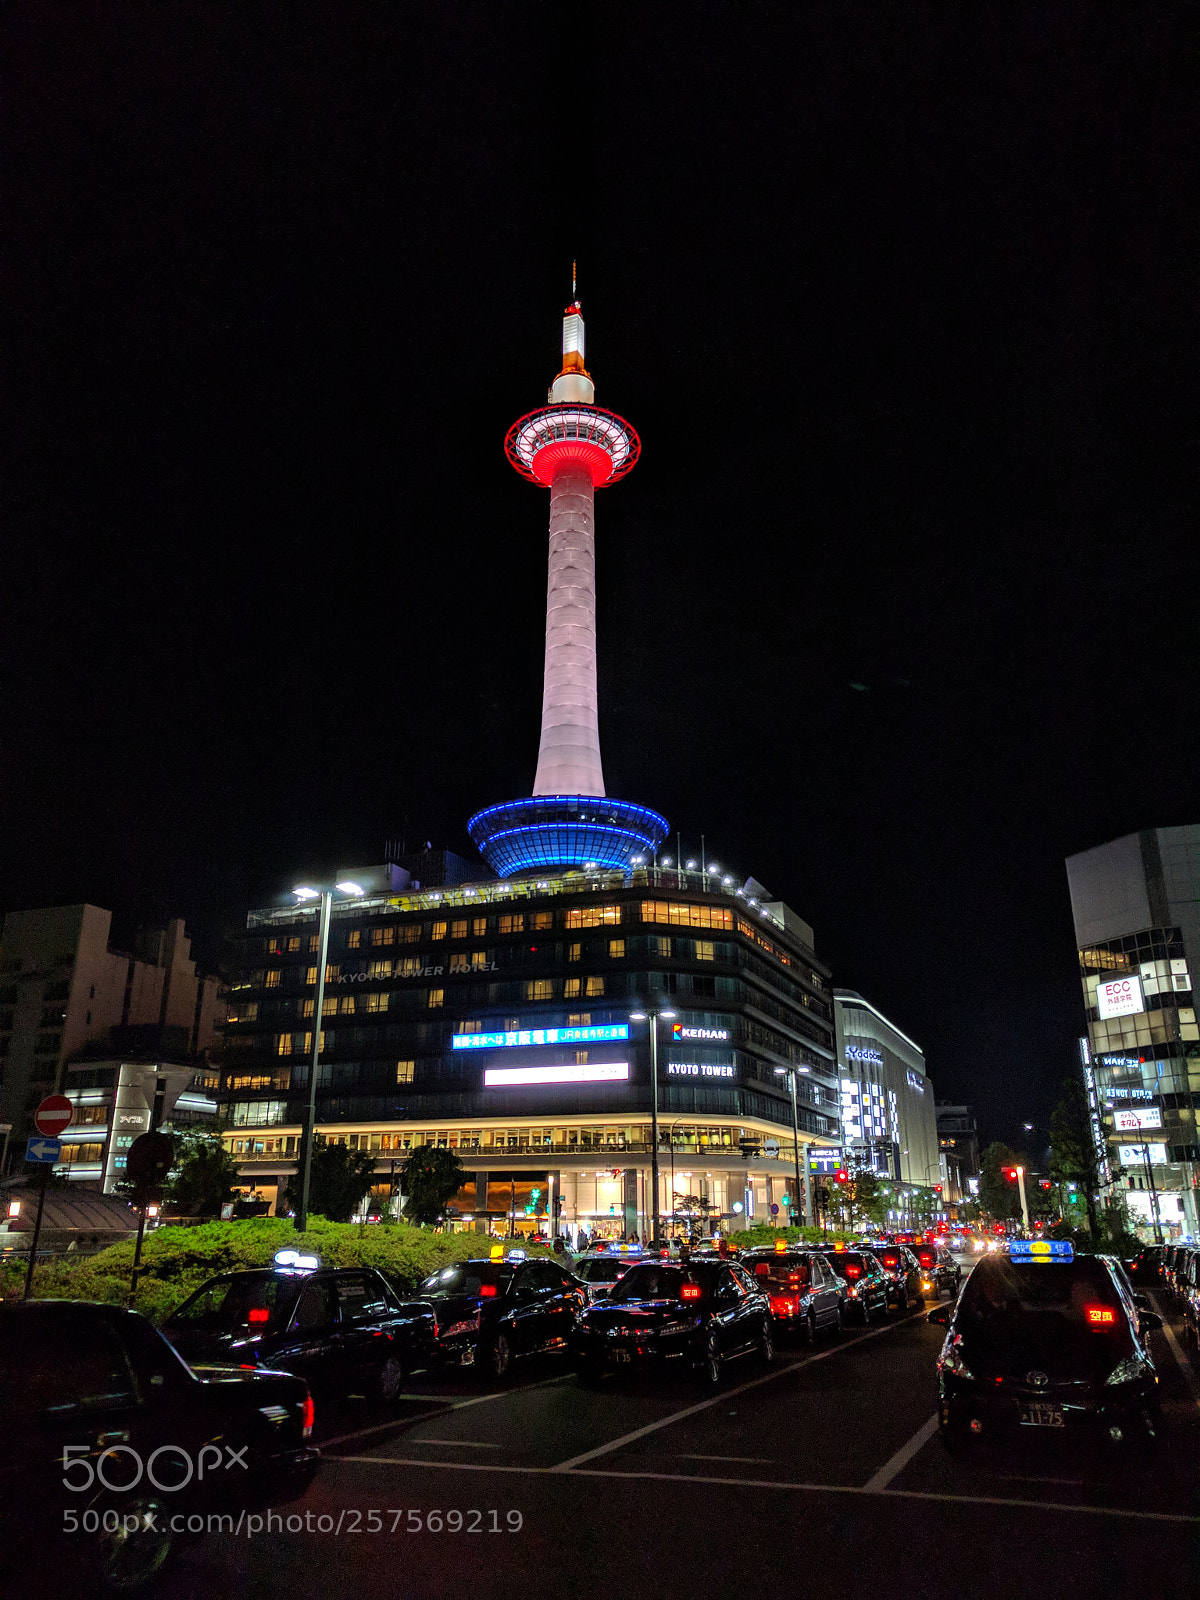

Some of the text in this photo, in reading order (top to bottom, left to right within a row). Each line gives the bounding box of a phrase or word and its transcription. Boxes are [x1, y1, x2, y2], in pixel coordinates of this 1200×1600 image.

[450, 961, 500, 975] HOTEL
[1105, 980, 1131, 996] ECC
[681, 1027, 727, 1040] KEIHAN
[668, 1063, 734, 1077] KYOTO TOWER
[1089, 1310, 1114, 1321] 空車
